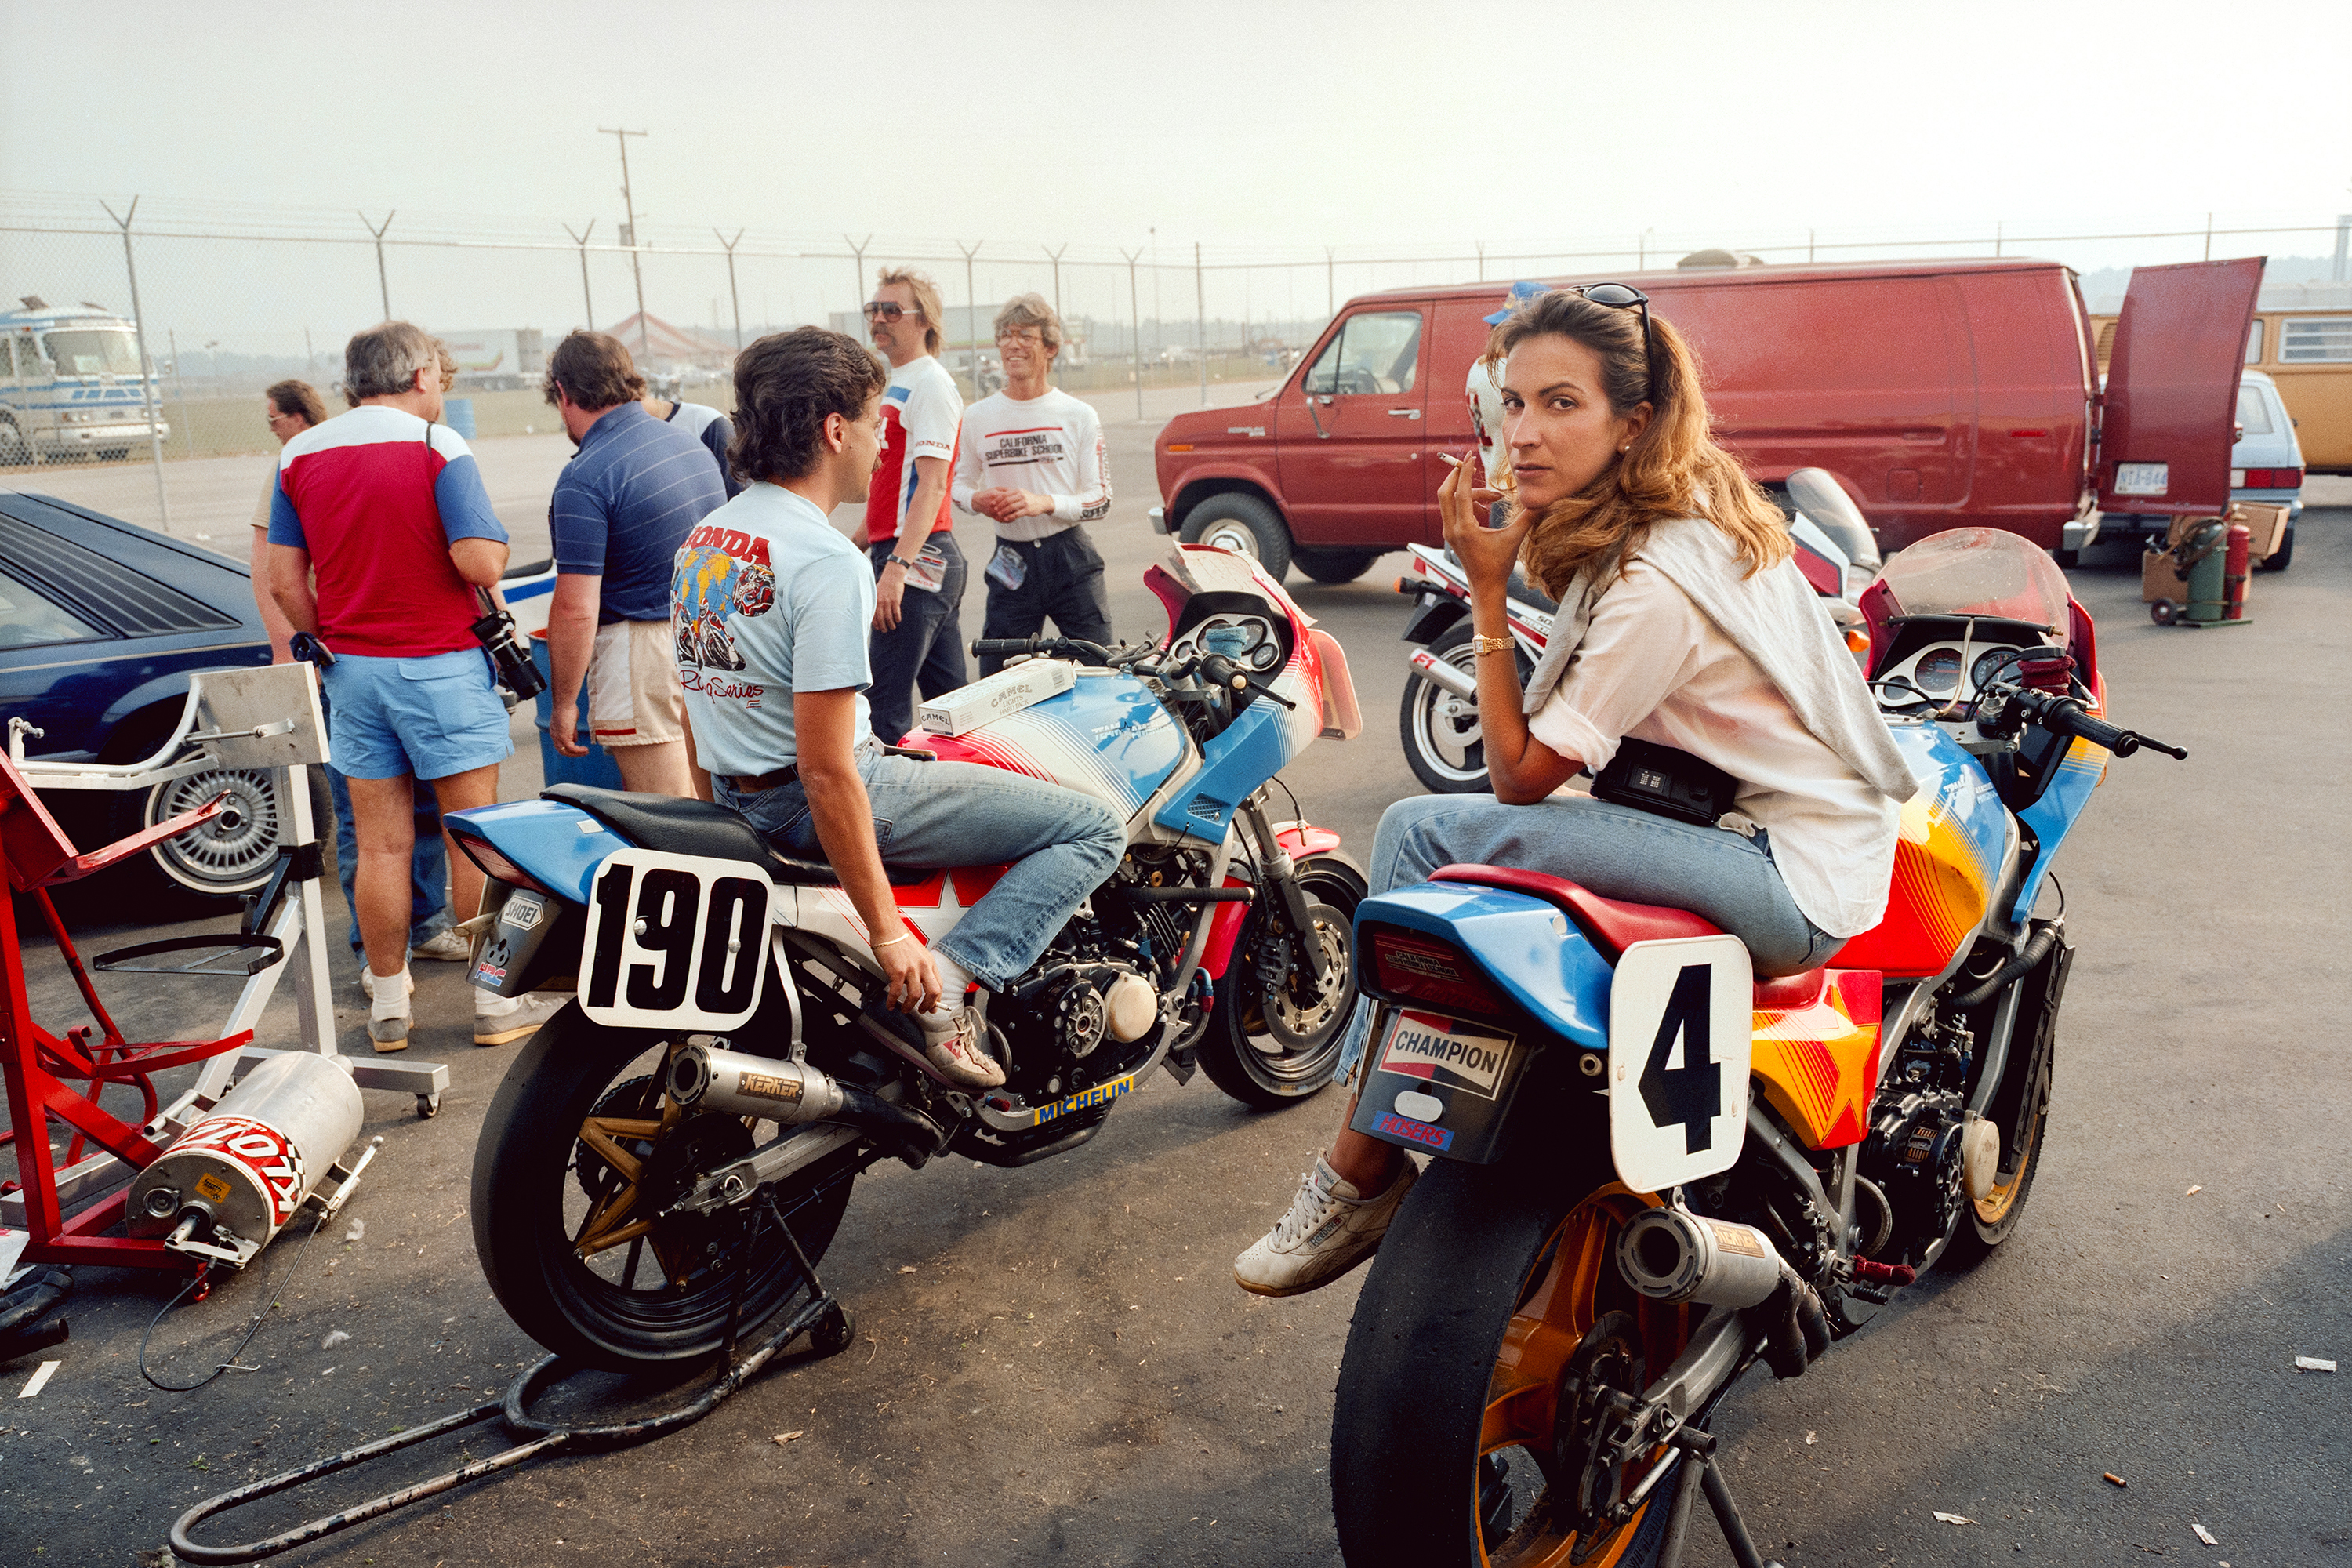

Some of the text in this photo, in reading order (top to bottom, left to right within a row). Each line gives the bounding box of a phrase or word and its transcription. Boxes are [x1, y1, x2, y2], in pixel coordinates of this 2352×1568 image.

[985, 447, 1028, 461] SUPERBIKE
[1032, 444, 1063, 456] SCHOOL
[1000, 435, 1047, 448] CALIFORNIA
[1414, 653, 1436, 670] F1
[711, 677, 764, 699] Series
[991, 684, 1033, 708] CAMEL
[1000, 699, 1029, 715] HARD PACK
[1003, 695, 1024, 707] LIGHTS
[921, 713, 950, 726] CAMEL
[505, 901, 538, 924] SHOEI
[586, 863, 768, 1014] 190
[1385, 955, 1427, 971] SUPERBIKE
[1428, 964, 1458, 976] SCHOOL
[1396, 951, 1440, 967] CALIFORNIA
[474, 962, 507, 987] HRC
[1395, 1030, 1499, 1074] CHAMPION
[1638, 963, 1721, 1156] 4
[744, 1074, 800, 1098] KERKER
[1039, 1080, 1130, 1123] MICHELIN
[1379, 1115, 1447, 1147] HOSERS
[1309, 1222, 1338, 1247] Reebok
